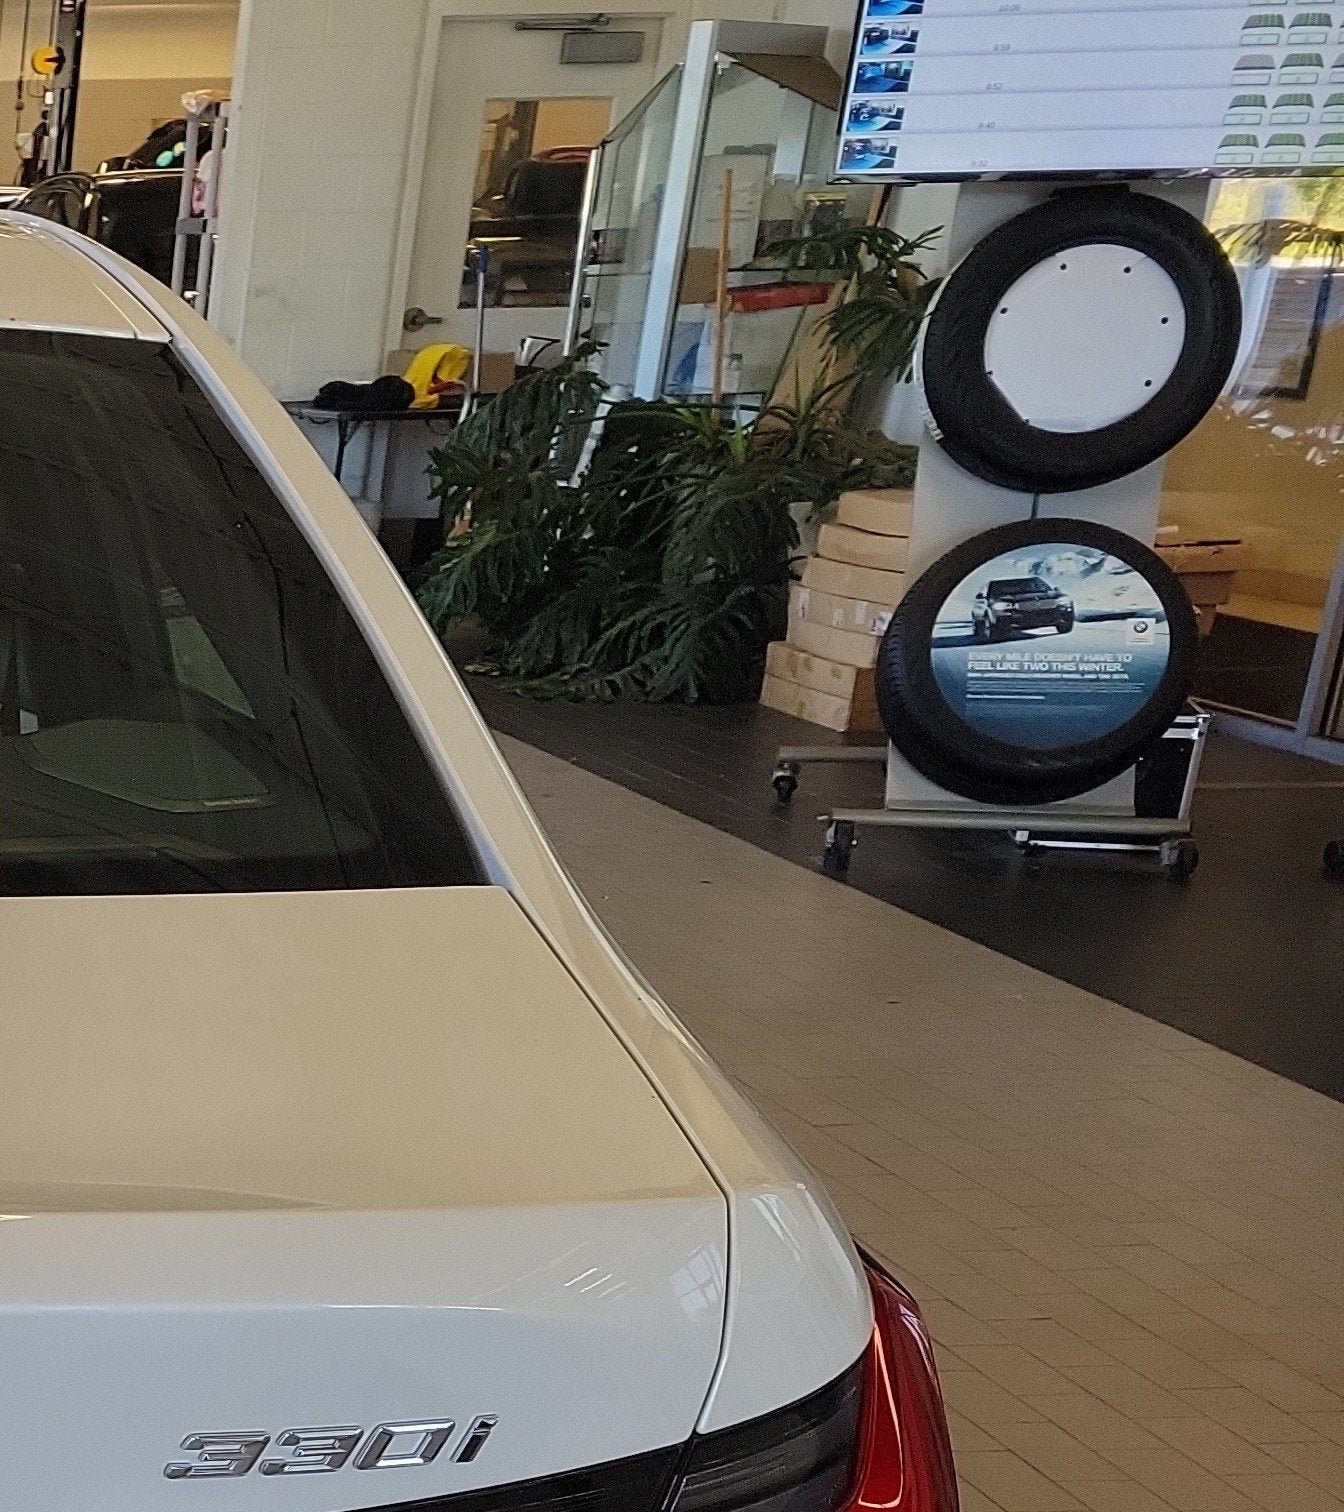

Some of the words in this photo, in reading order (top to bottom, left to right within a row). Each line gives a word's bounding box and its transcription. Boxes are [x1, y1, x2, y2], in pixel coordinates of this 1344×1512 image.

[1084, 653, 1115, 662] HAVE
[1116, 653, 1133, 663] TO
[968, 661, 995, 671] FEEL
[996, 661, 1021, 671] LIKE
[1023, 662, 1049, 671] TWO
[1050, 662, 1077, 671] THIS
[163, 1413, 500, 1480] 330i
